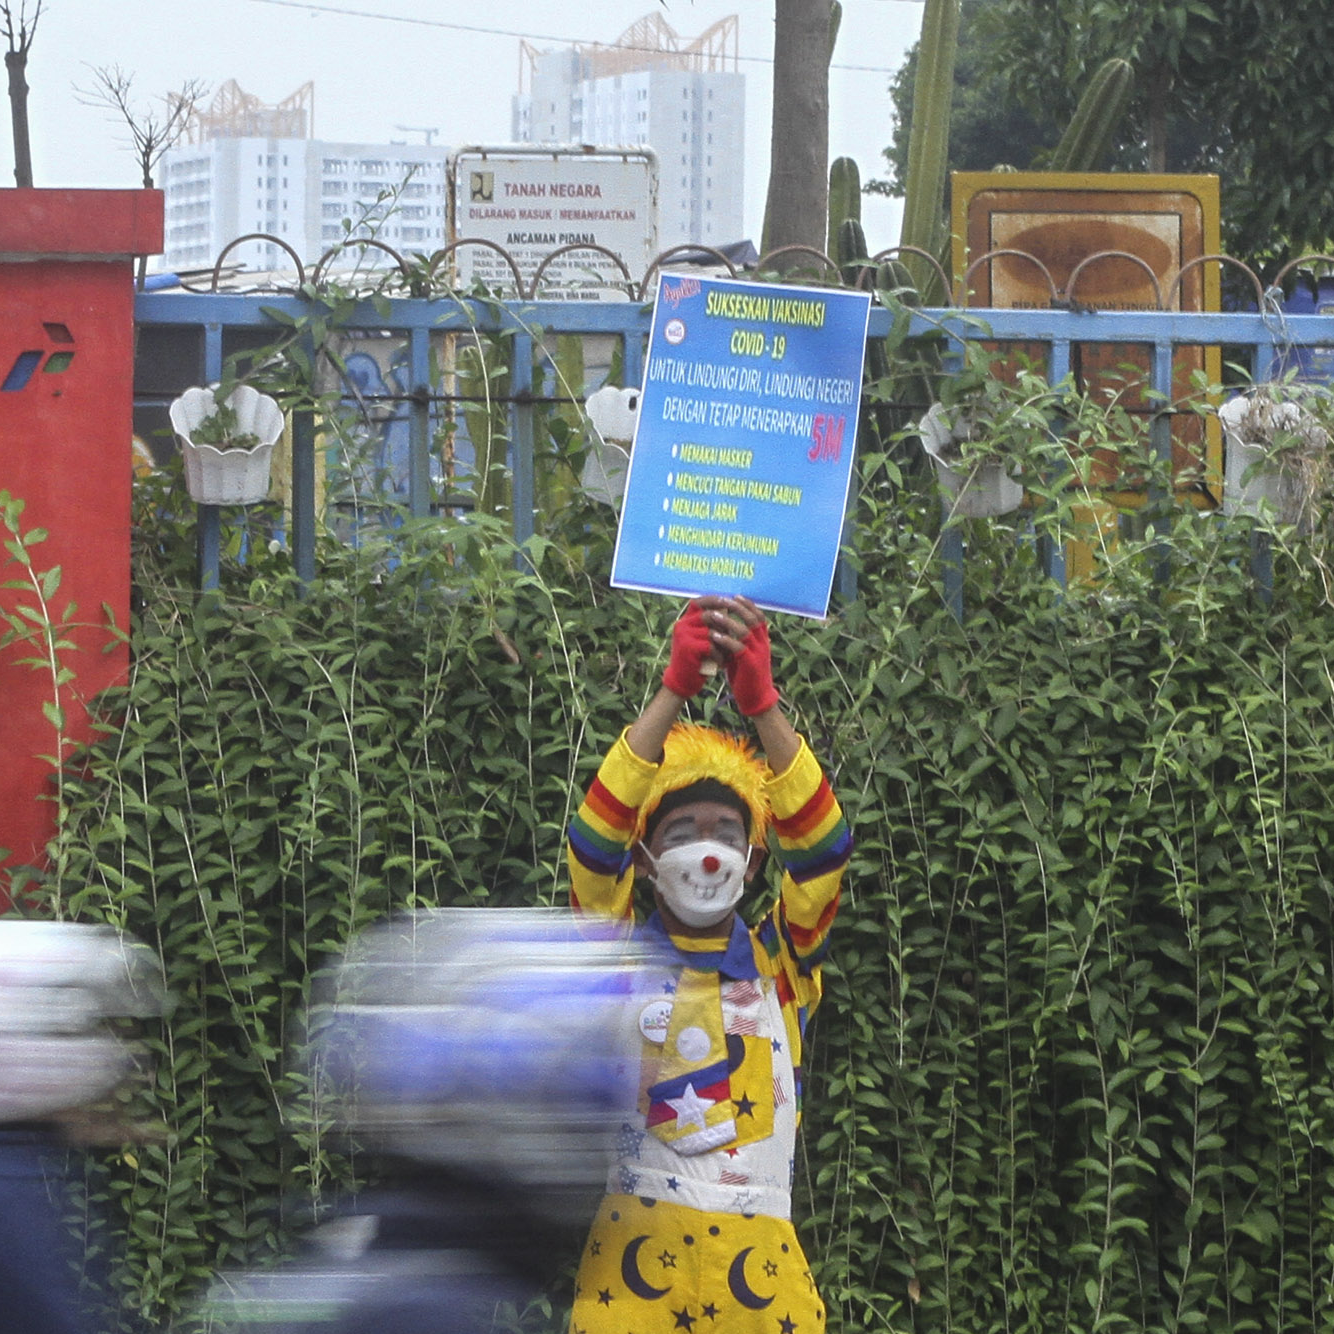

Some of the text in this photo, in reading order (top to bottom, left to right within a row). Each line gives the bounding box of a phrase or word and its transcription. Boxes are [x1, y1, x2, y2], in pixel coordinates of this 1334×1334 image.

[504, 183, 602, 198] TANAH NEGARA
[469, 208, 516, 220] DILARANG
[519, 209, 552, 220] MASUK
[559, 209, 635, 221] MEMANFAATKAN
[507, 233, 596, 245] ANCAMAN PIDANA
[706, 291, 769, 322] SUKSESKAN
[771, 299, 825, 327] VAKSINASI
[731, 330, 765, 356] COVID
[771, 335, 786, 359] 19
[650, 359, 854, 404] UNTUK LINDUNGI DIRI, LINDUNGI NEGERI
[662, 396, 845, 464] DENGAN TETAP MENERAPKAN 5M
[680, 443, 754, 469] MEMAKAI MASKER
[675, 472, 802, 506] MENCUCI TANGAN PAKAI SABUN
[671, 497, 738, 523] MENJAGA JARAK
[667, 524, 779, 557] MENGHINDARI KERUMUNAN
[663, 550, 755, 580] MEMBATASI MOBILITAS
